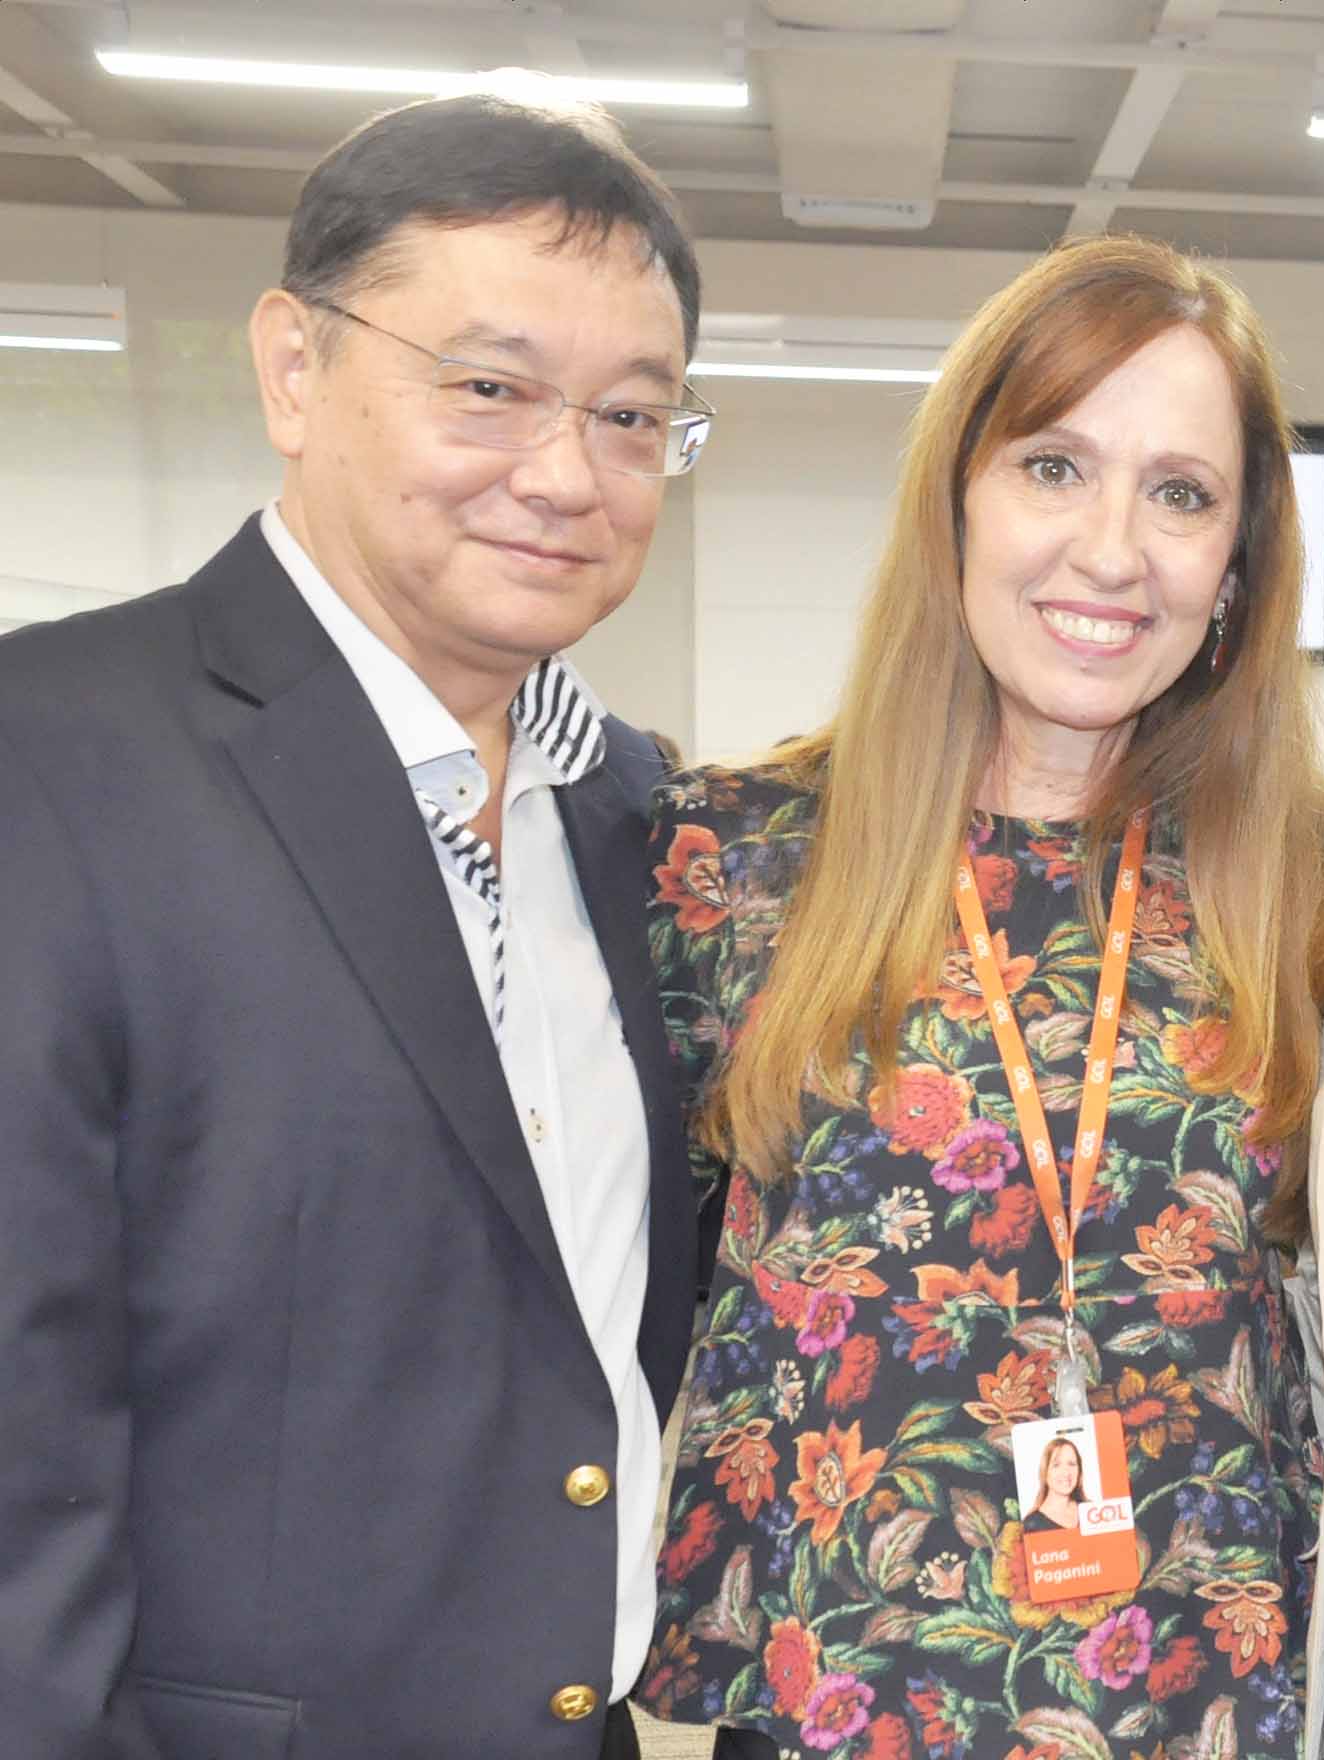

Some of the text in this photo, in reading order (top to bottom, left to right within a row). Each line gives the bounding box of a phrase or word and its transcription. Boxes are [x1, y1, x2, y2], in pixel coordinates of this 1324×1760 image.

[1120, 869, 1135, 892] GOL
[973, 934, 990, 959] GOL
[1111, 931, 1125, 954] GOL
[993, 999, 1010, 1025] GOL
[1100, 995, 1116, 1019] GOL
[1013, 1065, 1031, 1093] GOL
[1092, 1059, 1107, 1084] GOL
[1032, 1139, 1049, 1169] GOL
[1079, 1130, 1096, 1158] GOL
[1087, 1504, 1128, 1524] GOL
[1032, 1549, 1069, 1565] Lana
[1034, 1562, 1101, 1584] Paganini
